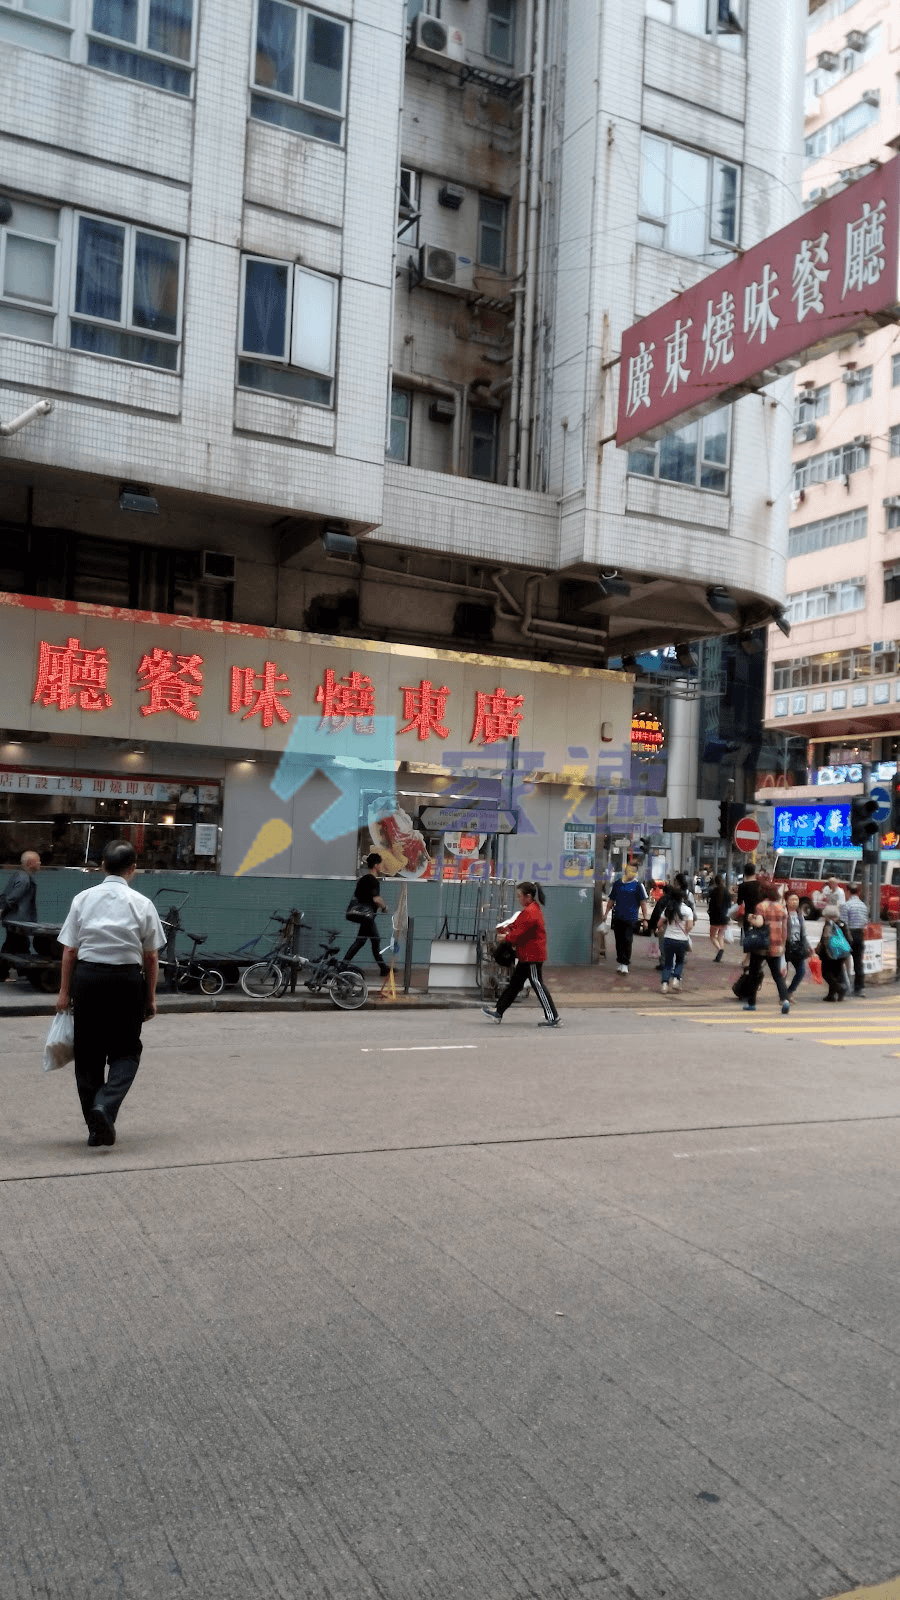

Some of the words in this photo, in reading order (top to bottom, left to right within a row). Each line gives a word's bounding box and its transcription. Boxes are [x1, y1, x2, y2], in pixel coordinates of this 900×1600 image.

[625, 199, 888, 419] 廣東燒味餐廳
[93, 778, 155, 797] 即燒即賣
